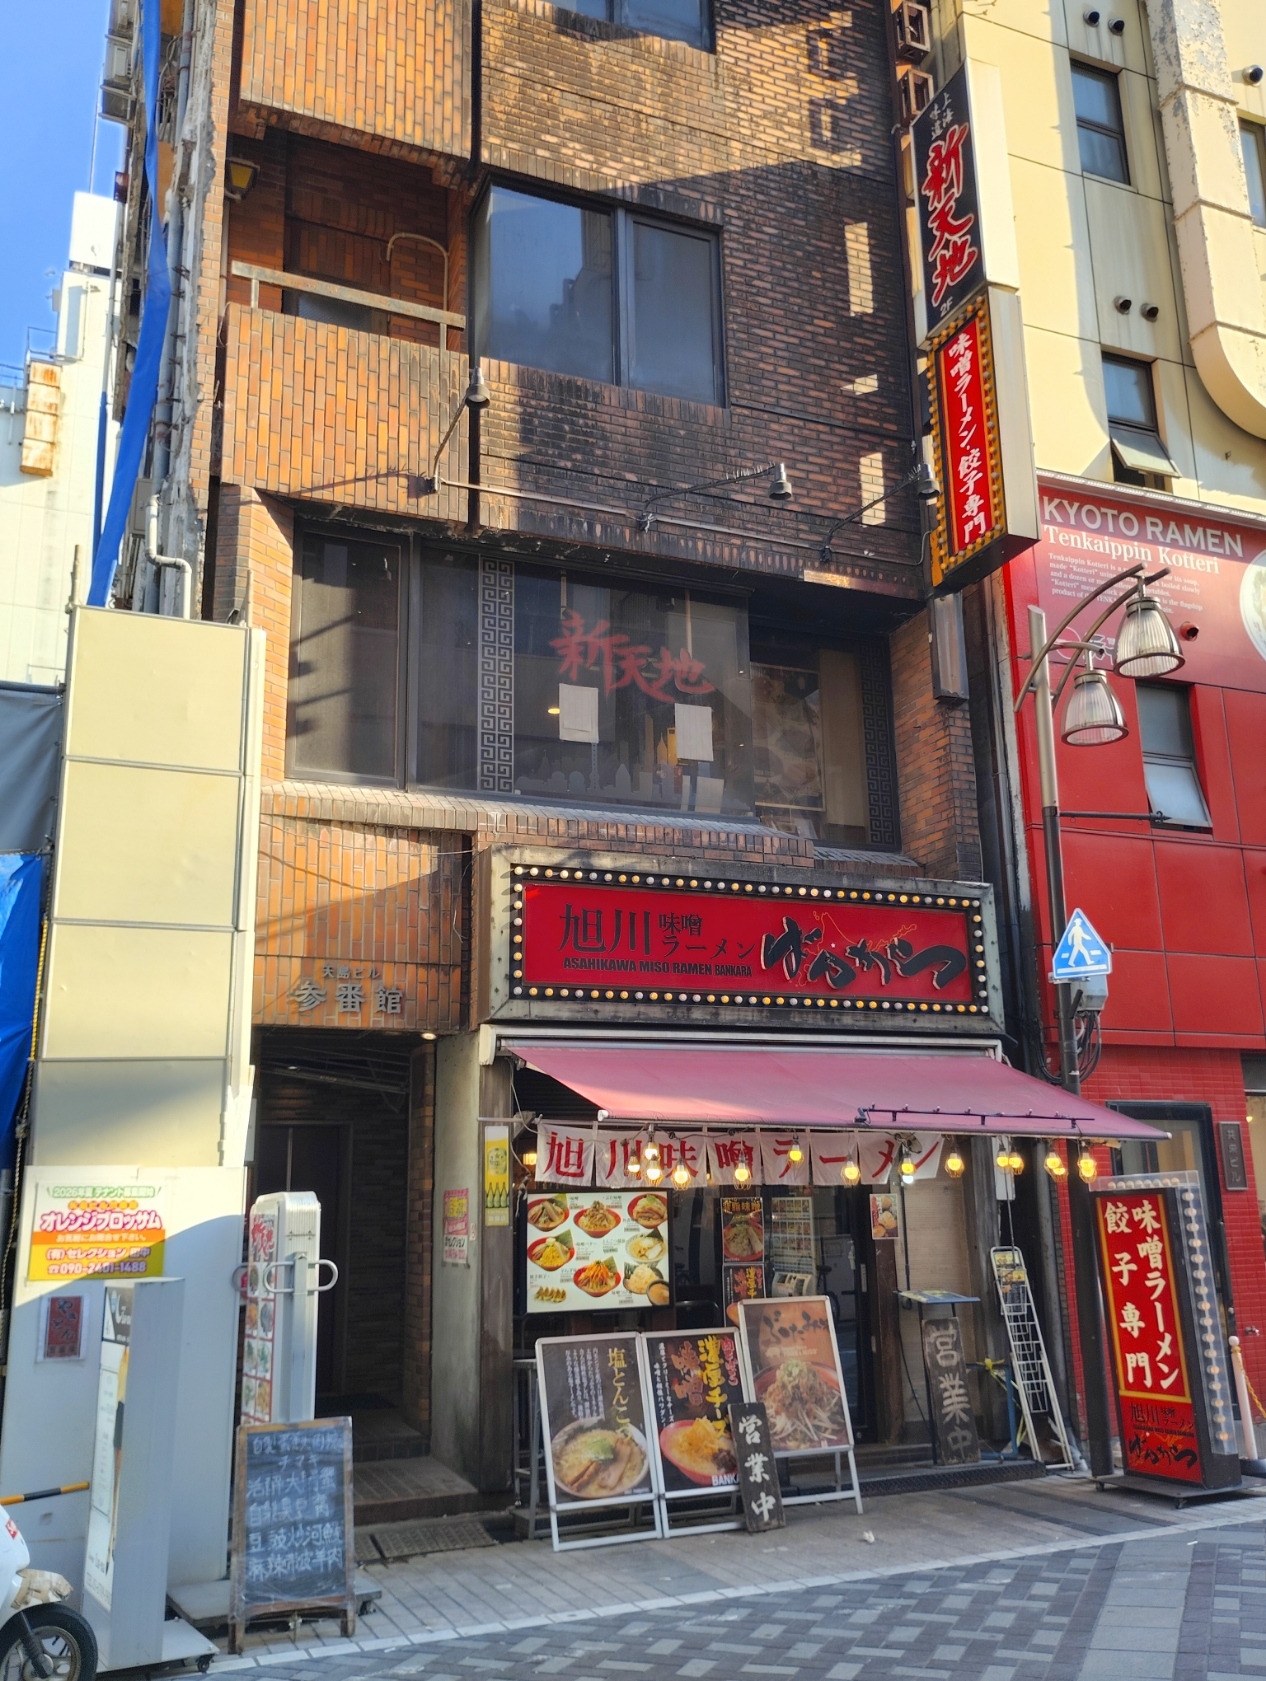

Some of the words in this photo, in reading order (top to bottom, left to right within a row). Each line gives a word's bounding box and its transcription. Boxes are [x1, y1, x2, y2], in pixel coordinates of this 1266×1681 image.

[921, 122, 978, 307] 新天地
[940, 296, 954, 318] 2F
[1043, 496, 1139, 537] KYOTO
[1145, 516, 1244, 557] RAMEN
[1044, 525, 1153, 562] Tenkaippin
[1157, 545, 1220, 574] Kotteri
[1048, 552, 1086, 566] Tenkaippin
[1087, 559, 1109, 570] Kotteri
[549, 608, 716, 704] 新天地
[558, 904, 651, 957] 旭川
[658, 912, 703, 936] 味噌
[662, 935, 755, 960] ラーメン
[563, 957, 637, 973] ASAHIKAWA
[639, 961, 670, 974] MISO
[672, 963, 713, 976] RAMEN
[715, 964, 753, 978] BANKARA
[295, 980, 403, 1014] 参番館
[40, 1210, 163, 1232] オレンジブロッサム
[1104, 1201, 1153, 1389] 餃子専門
[1131, 1199, 1180, 1390] 味噌ラーメン
[607, 1347, 633, 1442] 塩とんこつ
[928, 1321, 974, 1458] 営業中
[738, 1414, 776, 1522] 営業中
